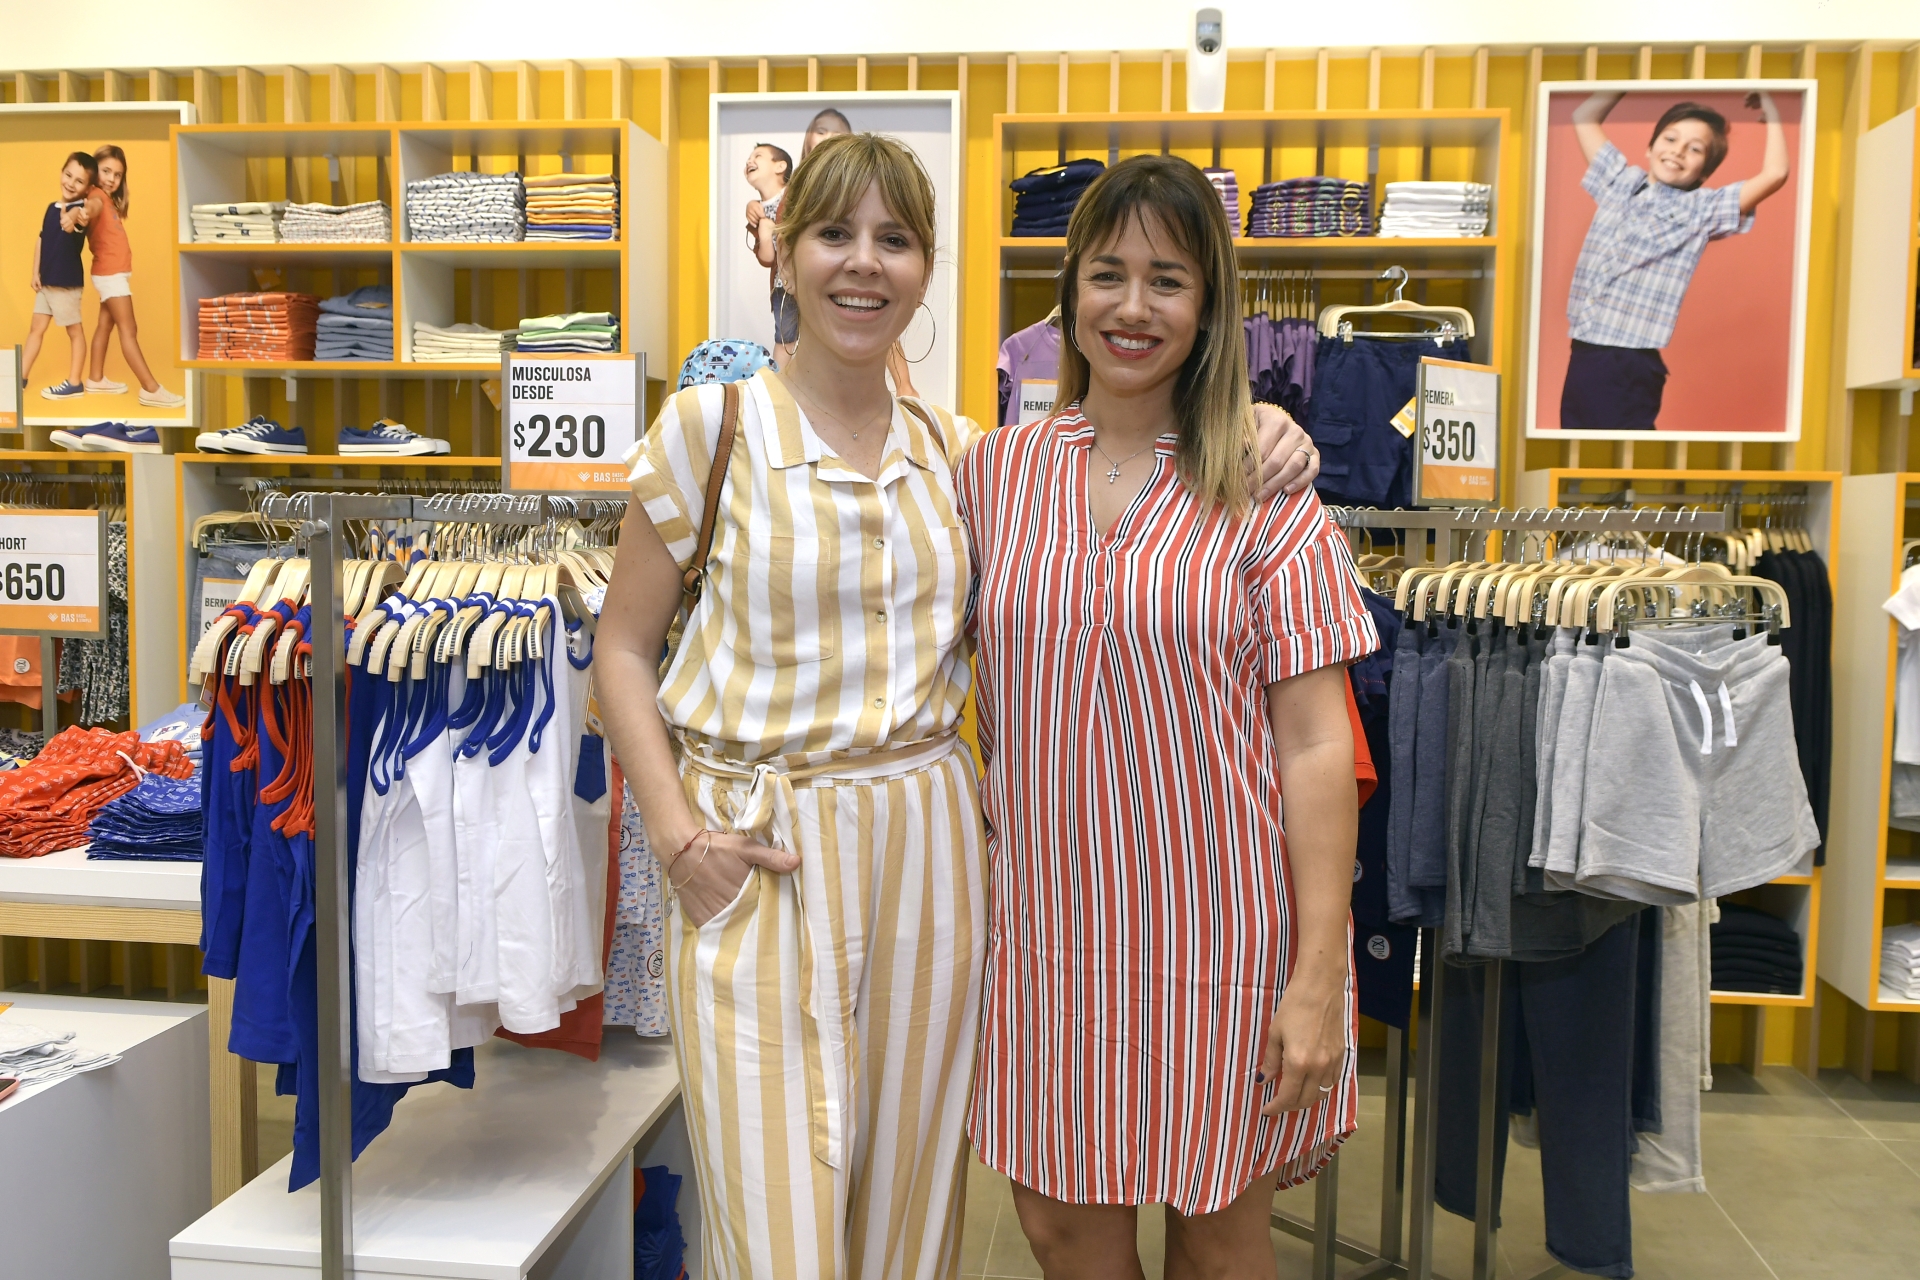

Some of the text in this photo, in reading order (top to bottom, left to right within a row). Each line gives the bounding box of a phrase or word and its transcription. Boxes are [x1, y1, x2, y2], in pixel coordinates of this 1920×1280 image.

[512, 367, 592, 381] MUSCULOSA
[512, 385, 554, 400] DESDE
[1425, 389, 1455, 406] REMERA
[1023, 400, 1054, 411] REMER
[513, 414, 606, 459] $230
[1423, 418, 1476, 462] $350
[593, 472, 611, 483] BAS
[0, 537, 27, 550] HORT
[60, 613, 76, 623] BAS
